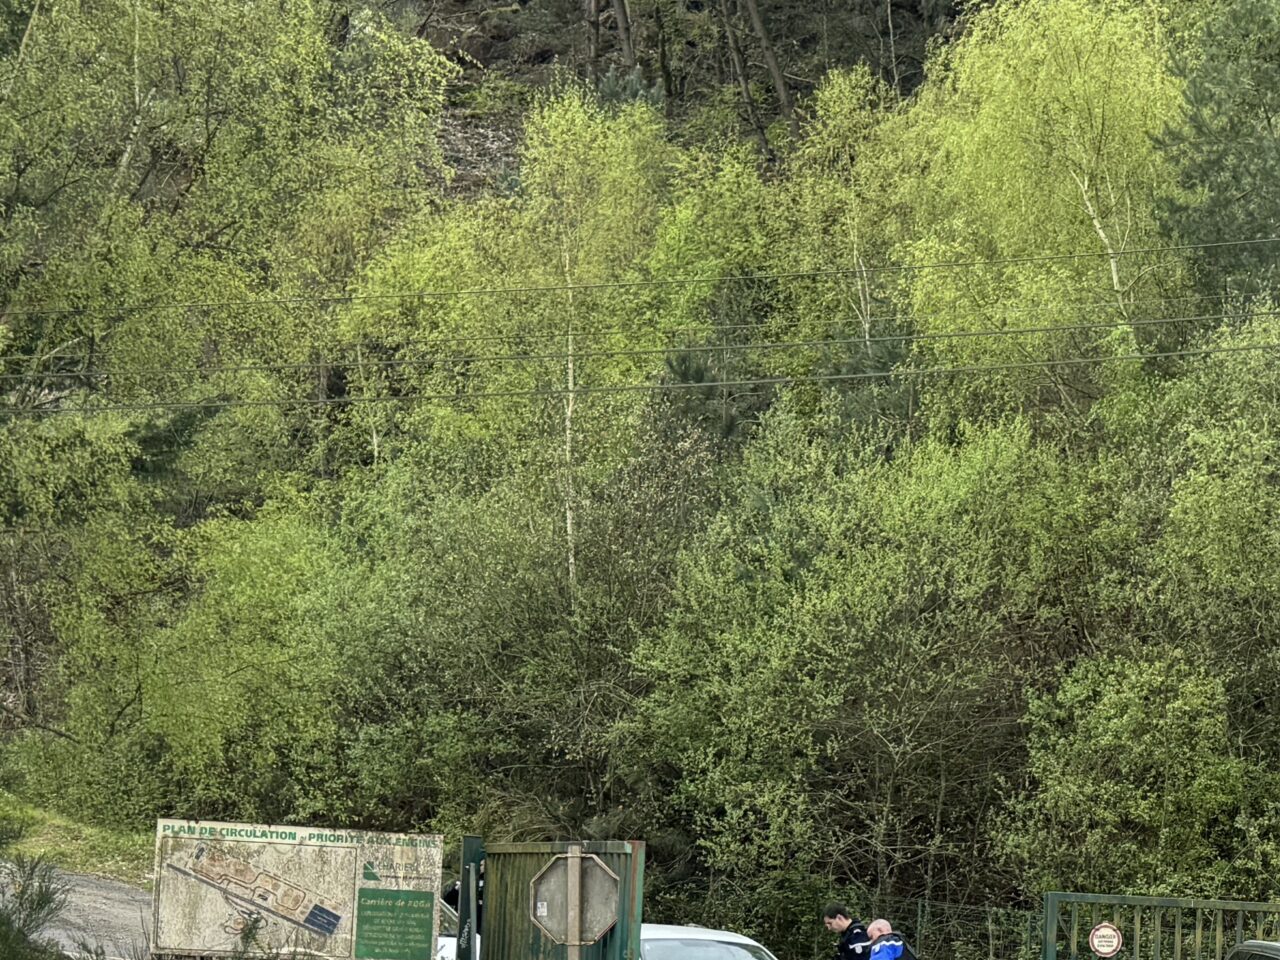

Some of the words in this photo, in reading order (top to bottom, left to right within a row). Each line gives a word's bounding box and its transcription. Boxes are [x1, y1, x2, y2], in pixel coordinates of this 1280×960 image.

[162, 824, 196, 835] PLAN
[199, 826, 216, 836] DE
[219, 827, 297, 841] CIRCULATION
[366, 837, 392, 846] AUX
[395, 838, 438, 849] ENGINS
[395, 899, 406, 908] de
